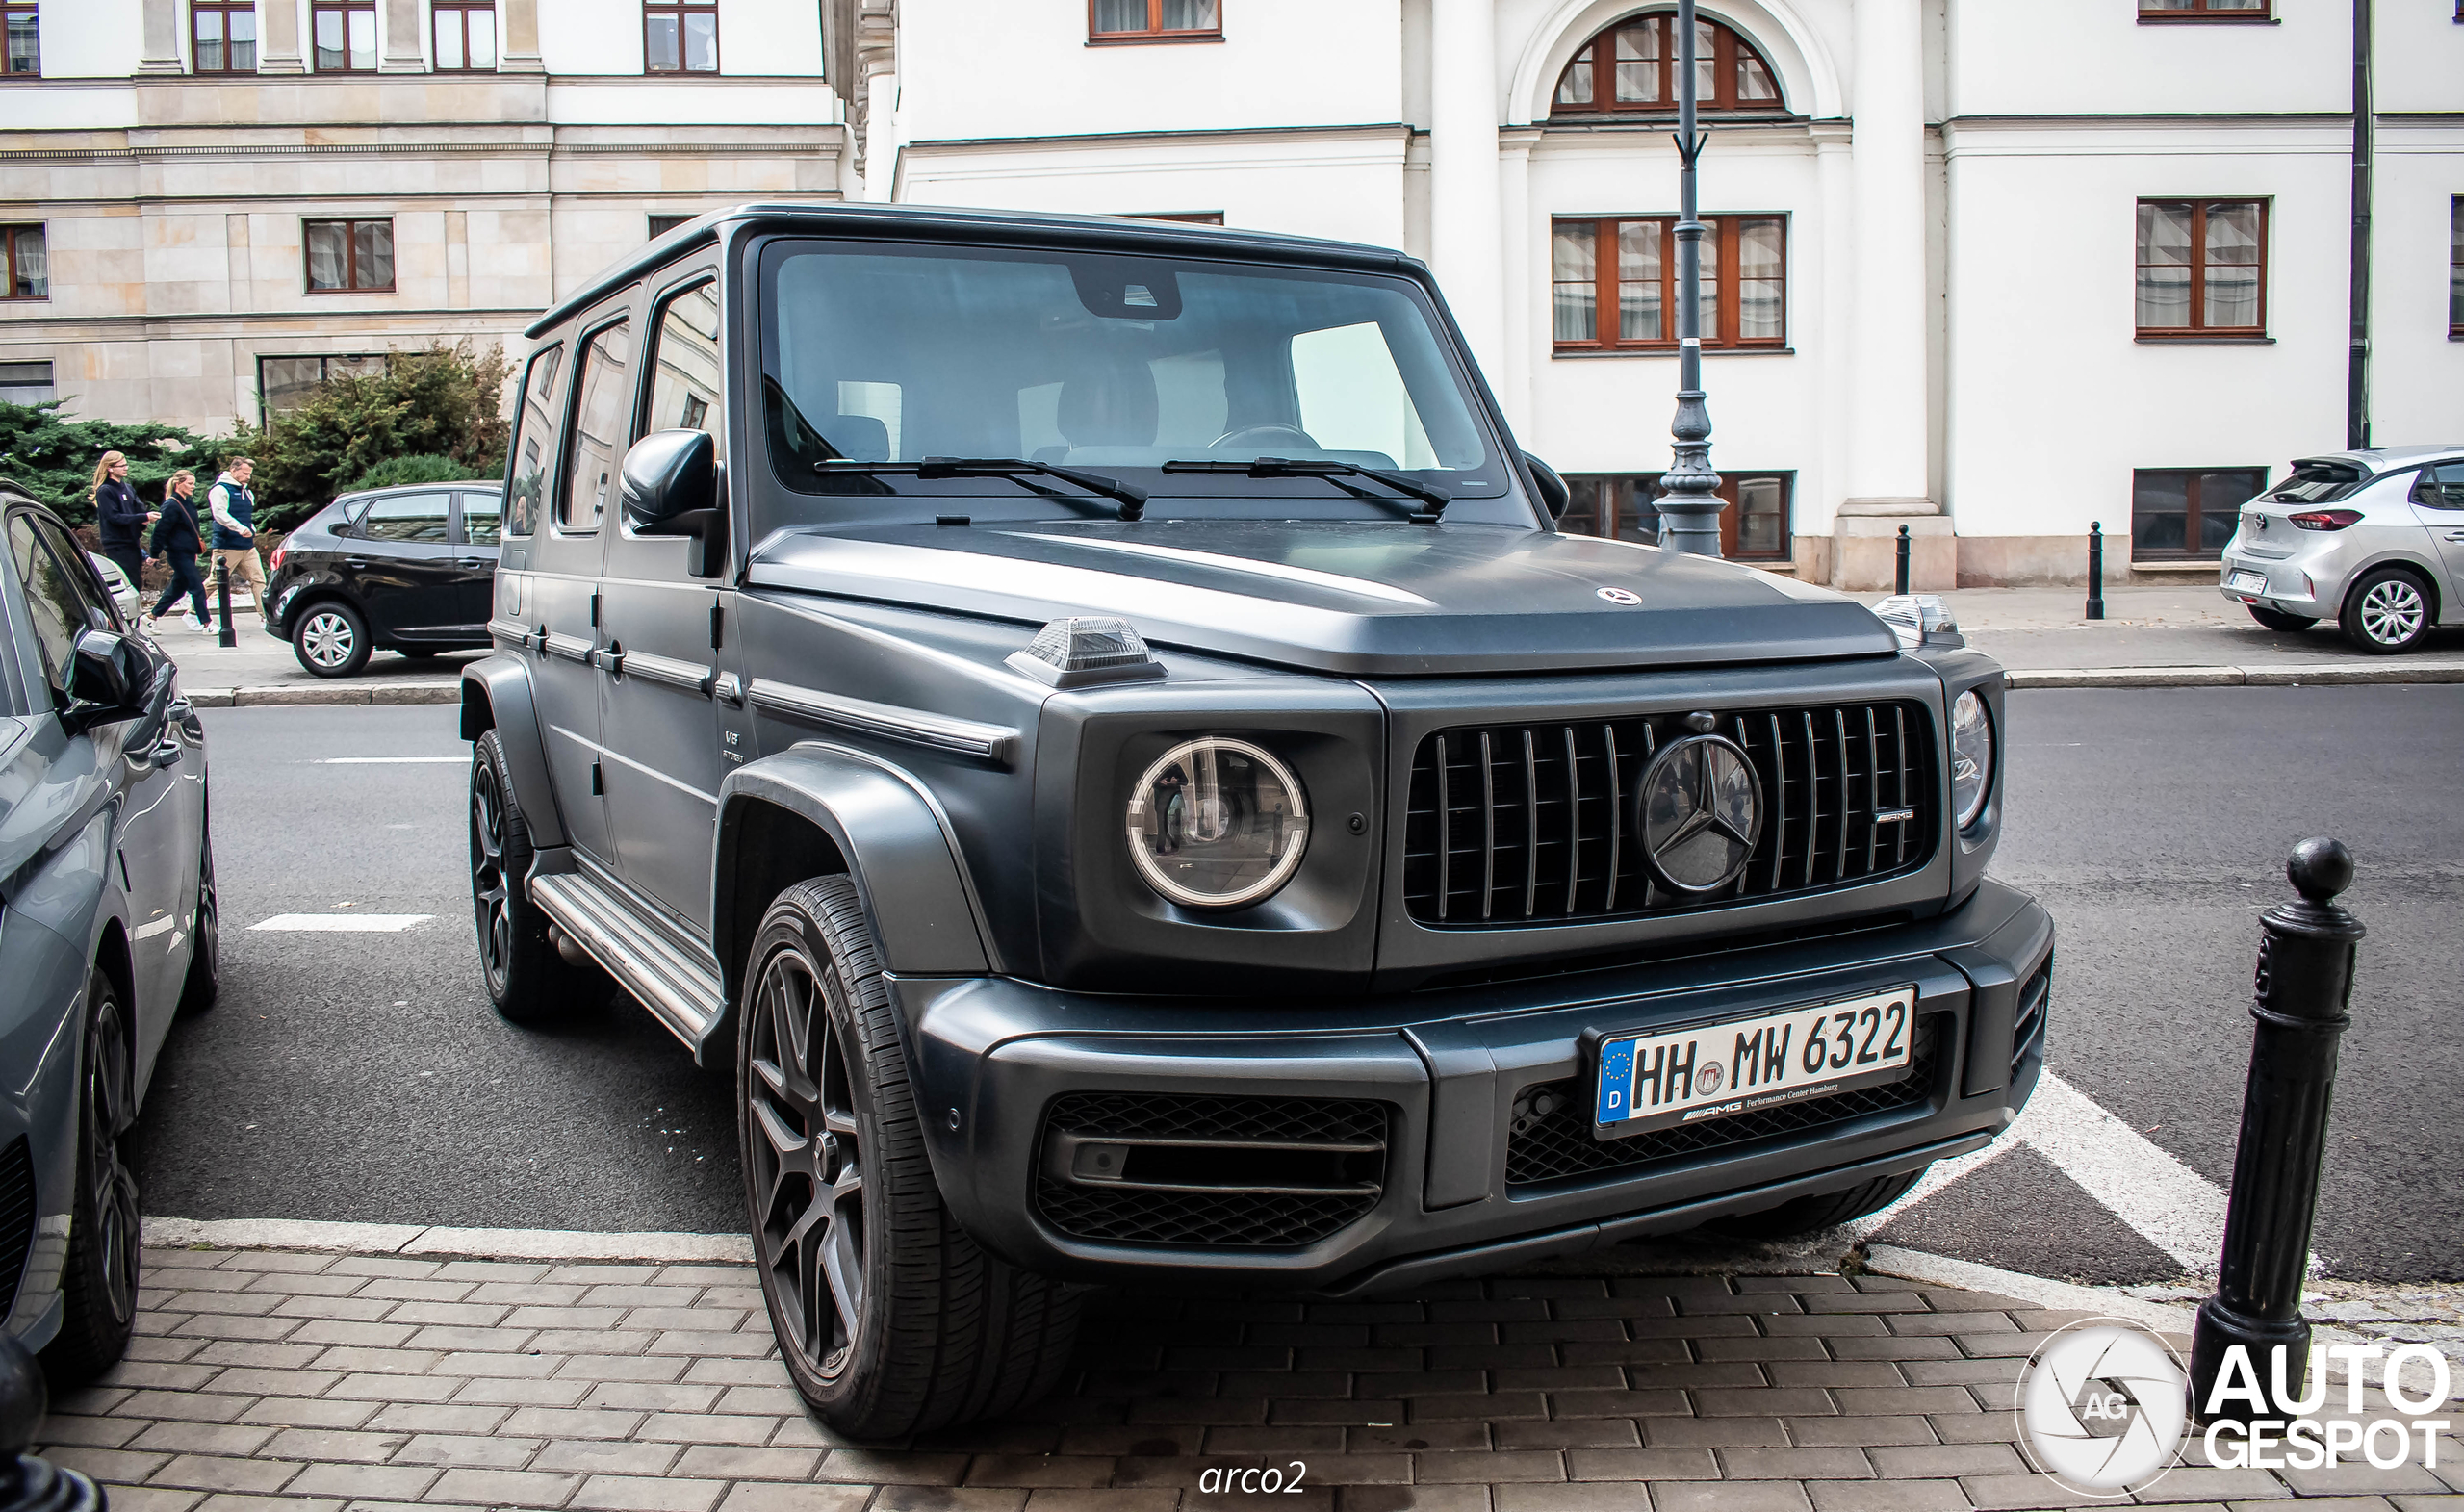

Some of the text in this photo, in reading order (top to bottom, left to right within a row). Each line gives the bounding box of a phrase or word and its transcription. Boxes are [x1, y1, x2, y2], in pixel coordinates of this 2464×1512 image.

[1632, 1000, 1907, 1110] HH MW 6322
[1608, 1090, 1622, 1109] D
[1746, 1093, 1787, 1108] Performance
[1787, 1089, 1810, 1100] Center
[1810, 1083, 1839, 1095] Hamburg
